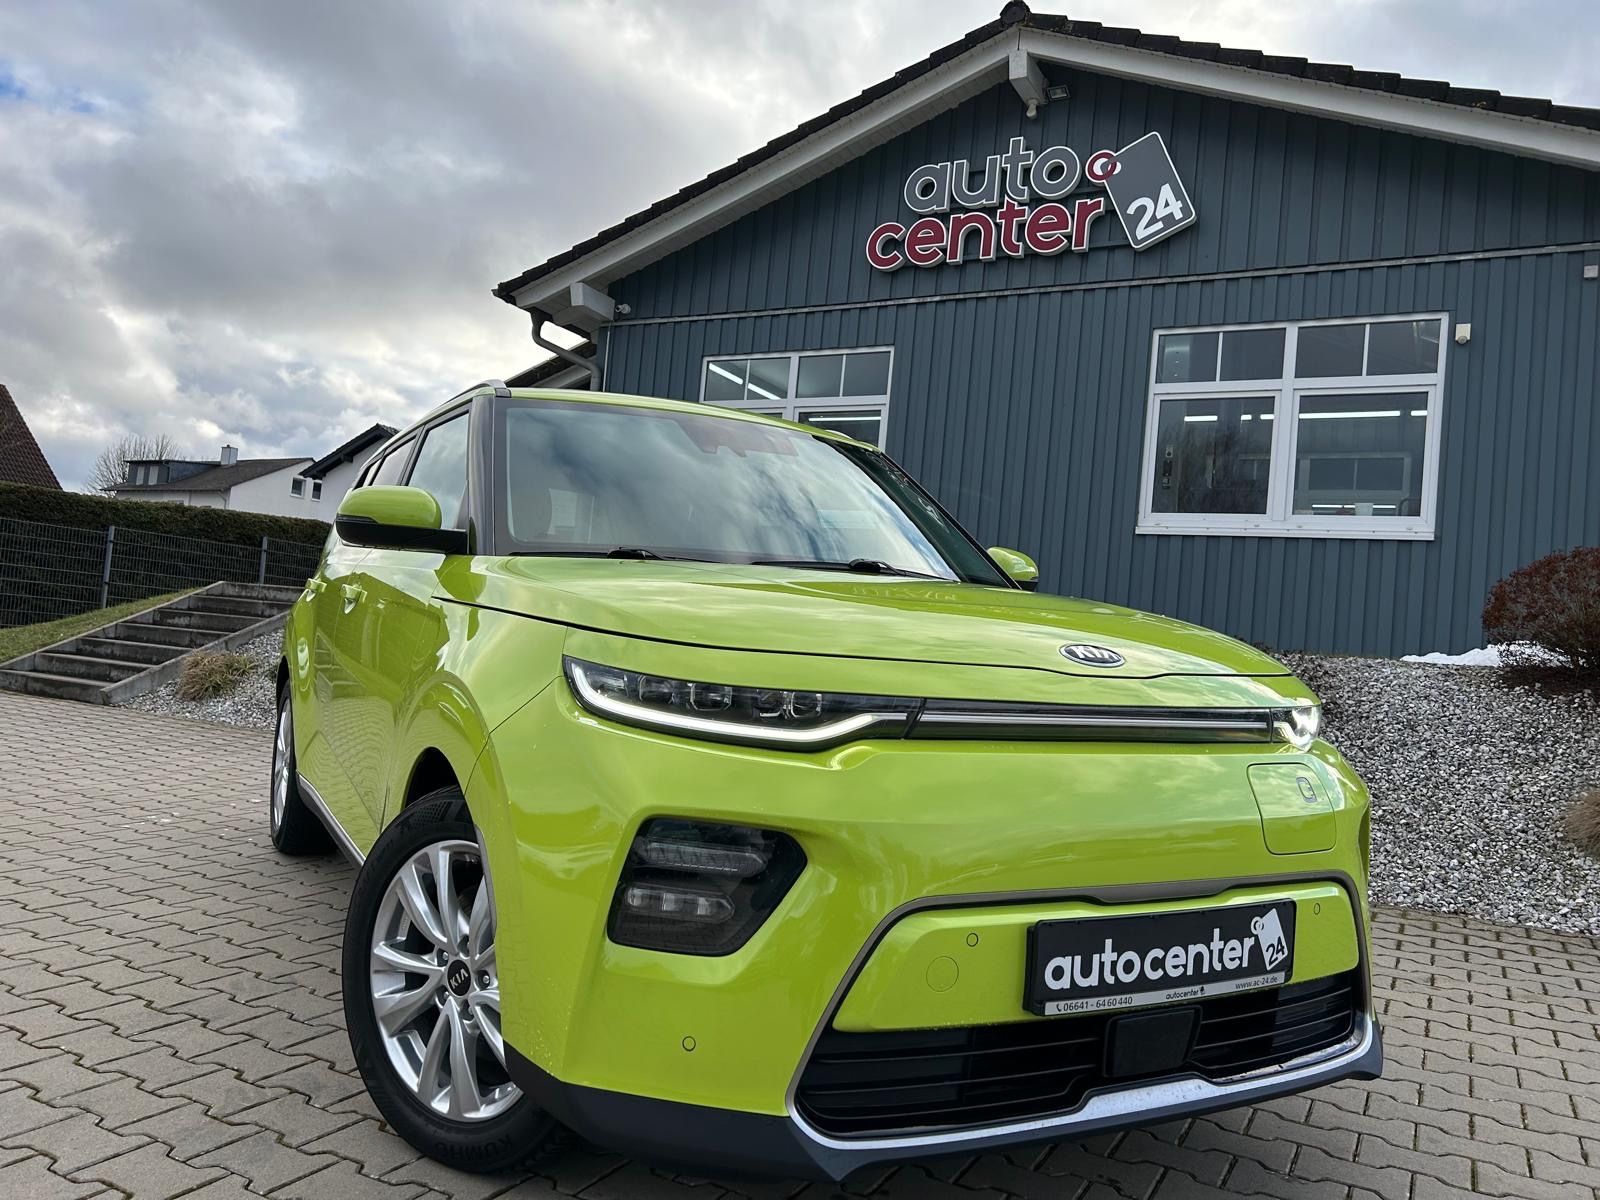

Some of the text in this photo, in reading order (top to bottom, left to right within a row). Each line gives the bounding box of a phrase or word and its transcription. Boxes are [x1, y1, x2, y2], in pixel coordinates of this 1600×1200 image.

[904, 136, 1081, 212] auto
[1127, 183, 1183, 240] 24
[866, 196, 1105, 272] center
[1266, 936, 1285, 966] 24
[450, 968, 468, 989] KIA
[1235, 976, 1278, 990] www.ac-24.de
[1165, 988, 1199, 1000] autocenter
[1063, 1002, 1089, 1012] 06641
